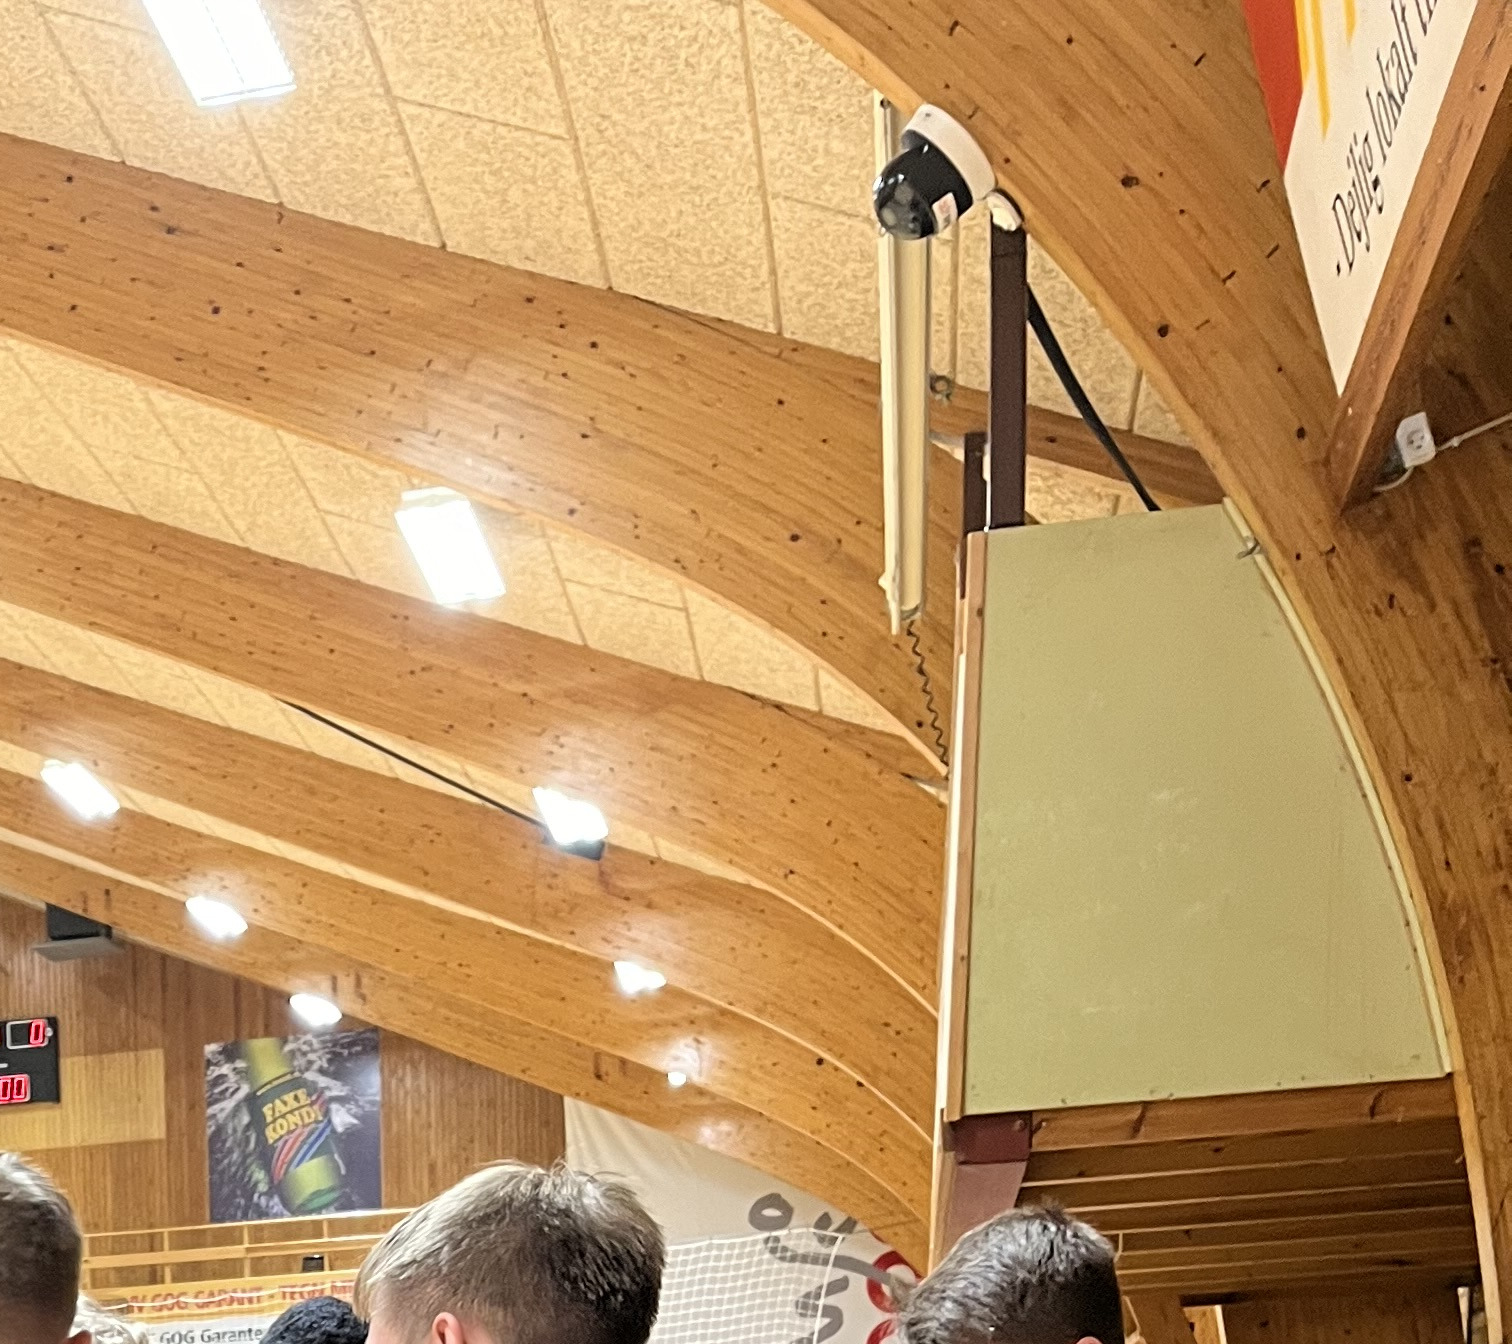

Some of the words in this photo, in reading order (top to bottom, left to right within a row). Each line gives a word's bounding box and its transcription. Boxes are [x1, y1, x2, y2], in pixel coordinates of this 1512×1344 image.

[29, 1019, 45, 1045] 0
[262, 1088, 311, 1123] FAXE
[264, 1104, 324, 1145] KONDI
[200, 1327, 264, 1344] Garante
